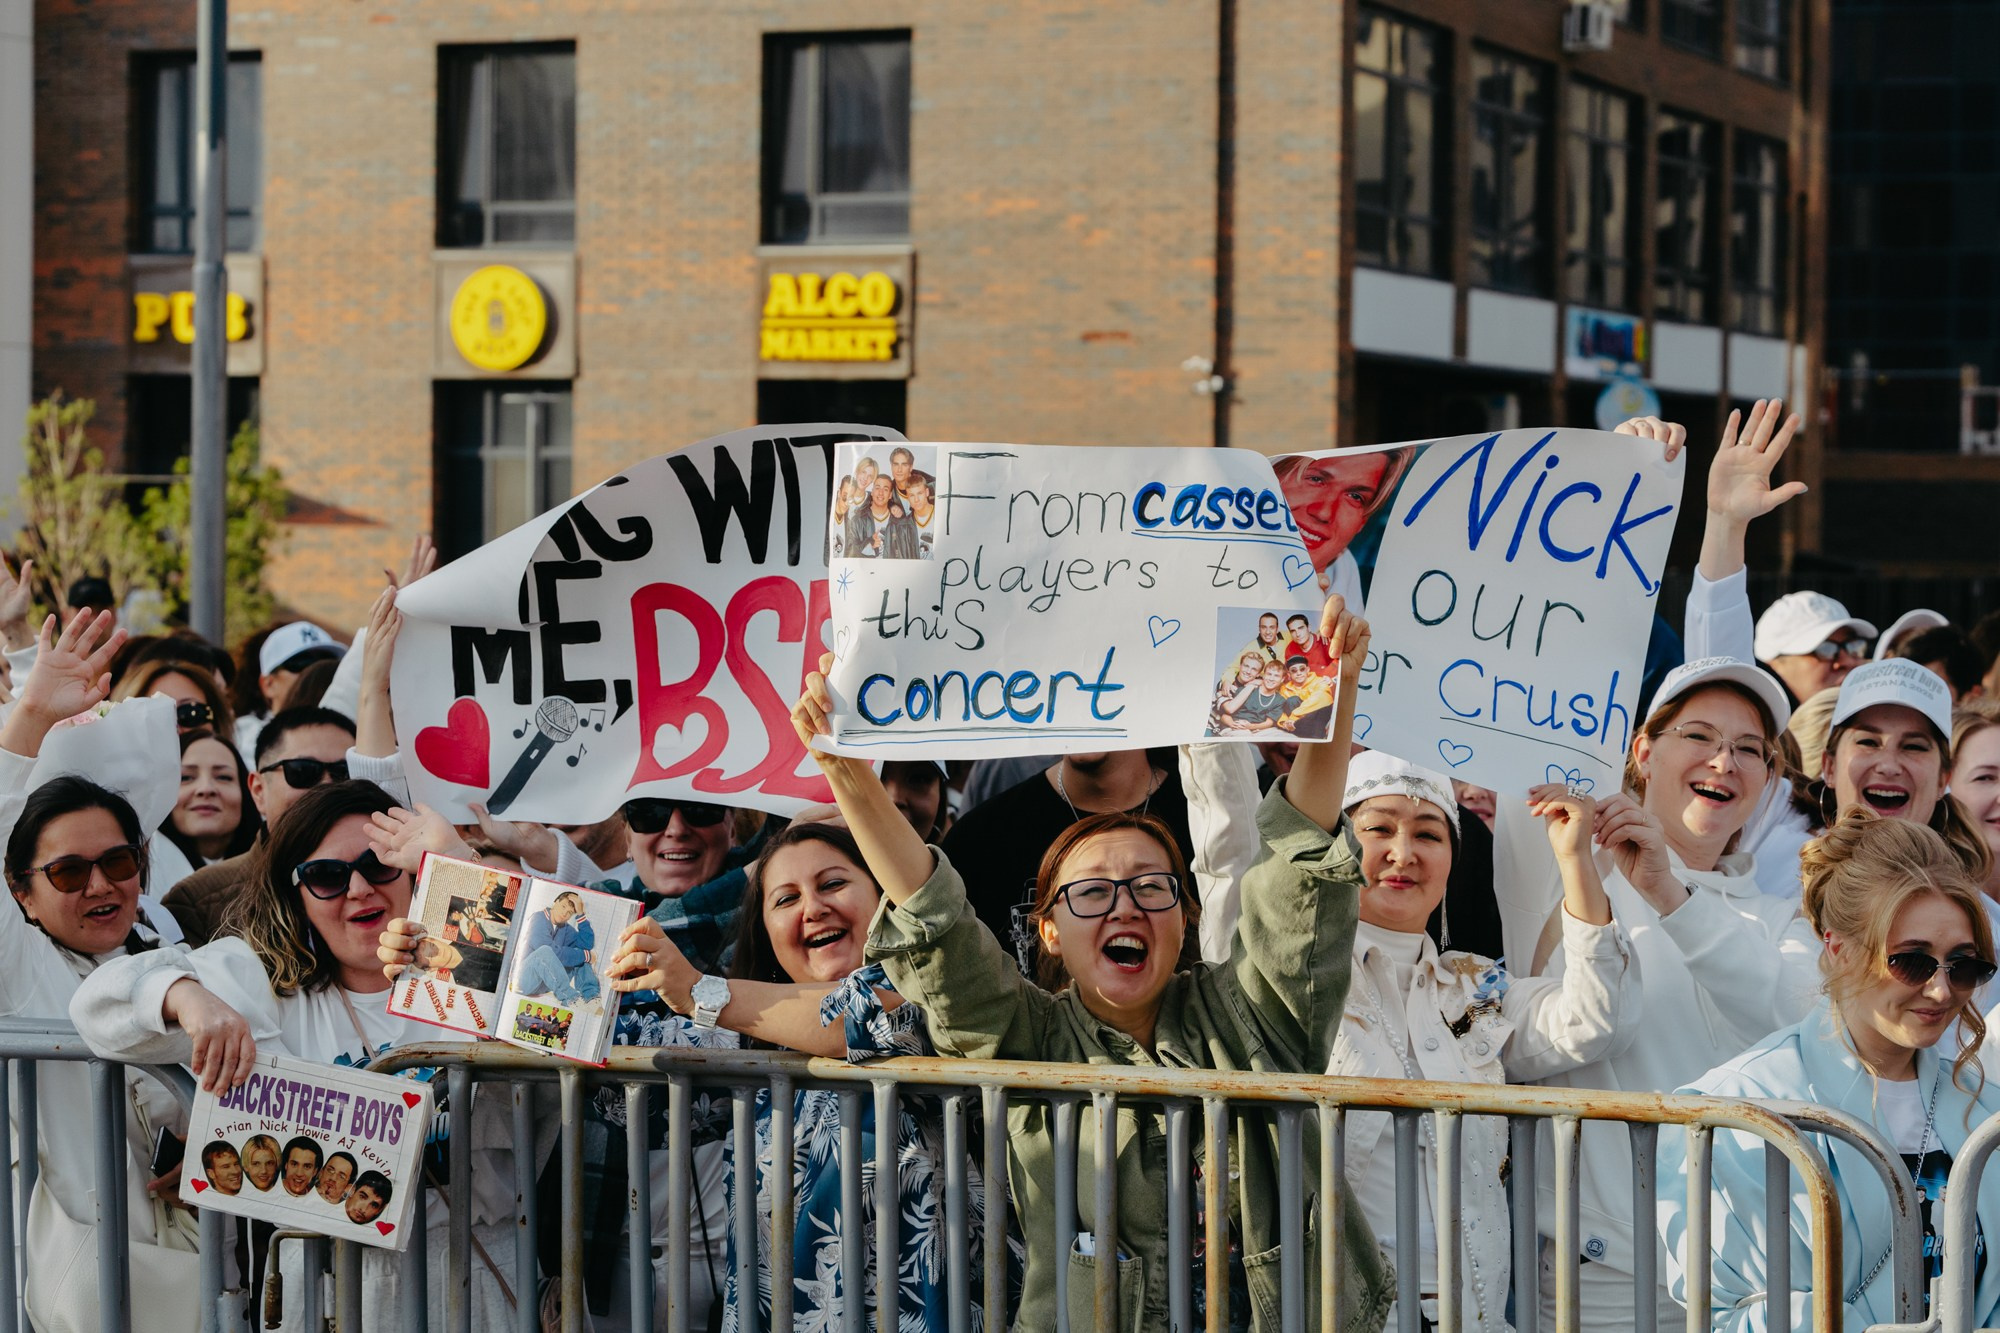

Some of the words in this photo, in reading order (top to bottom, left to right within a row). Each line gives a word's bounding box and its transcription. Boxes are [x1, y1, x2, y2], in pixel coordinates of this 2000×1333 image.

[763, 272, 896, 317] ALCO
[761, 328, 897, 361] MARKET
[665, 433, 887, 566] WIT
[938, 451, 1127, 543] From
[940, 545, 1160, 613] players
[1207, 545, 1259, 590] to
[1411, 568, 1586, 658] our
[856, 646, 1126, 726] concert
[1858, 679, 1907, 694] ASTANA
[445, 988, 456, 1009] BOYS
[214, 1121, 252, 1139] Brian
[260, 1119, 288, 1133] Nick
[296, 1124, 330, 1142] Howie
[337, 1136, 357, 1150] AJ
[361, 1145, 392, 1177] Kevin
[350, 1096, 405, 1146] BOYS
